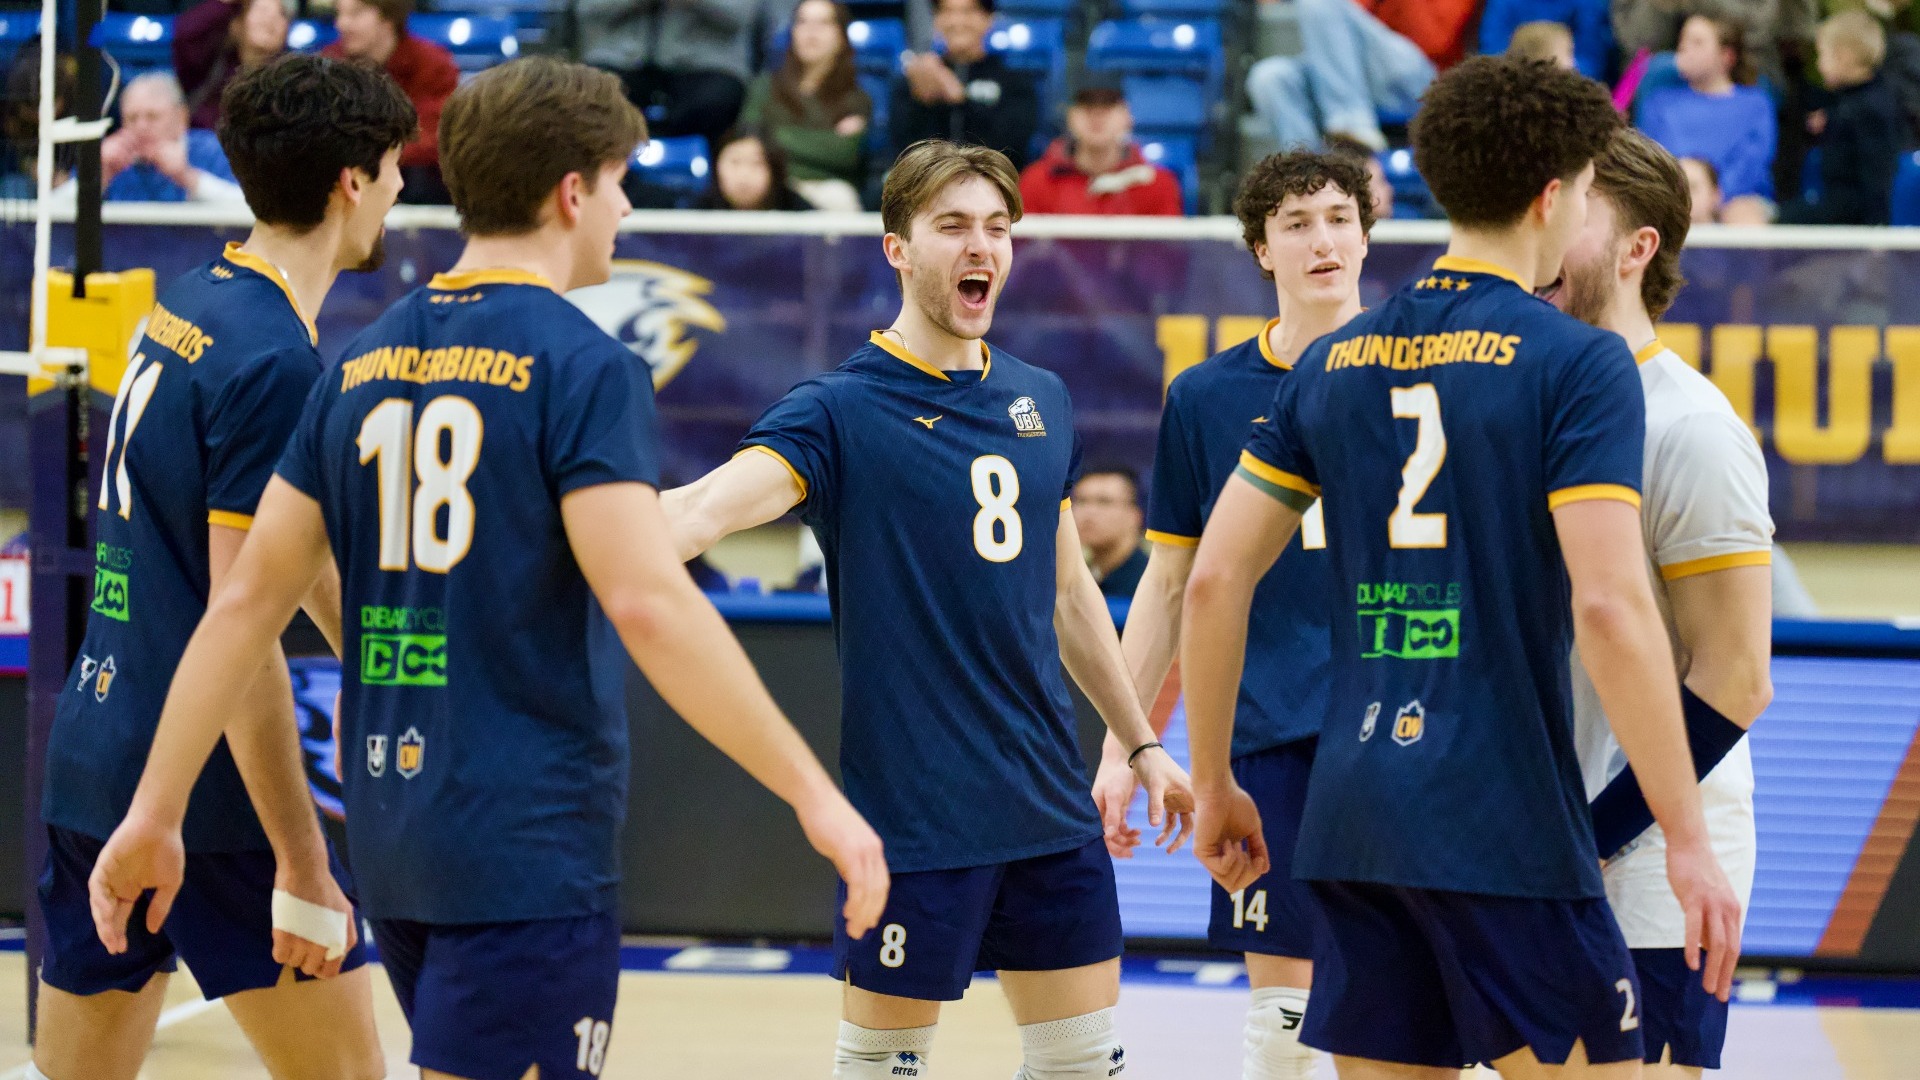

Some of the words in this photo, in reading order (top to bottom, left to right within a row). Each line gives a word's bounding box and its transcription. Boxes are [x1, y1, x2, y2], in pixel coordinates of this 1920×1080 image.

[341, 345, 534, 393] THUNDERBIRDS
[1325, 330, 1521, 373] THUNDERBIRDS
[98, 352, 163, 521] 11
[1013, 411, 1045, 431] UBC
[355, 395, 484, 574] 18
[1388, 382, 1447, 549] 2
[970, 454, 1023, 563] 8
[1230, 888, 1270, 933] 14
[879, 923, 907, 968] 8
[1615, 977, 1640, 1033] 2
[573, 1016, 610, 1076] 18
[891, 1065, 918, 1077] errea
